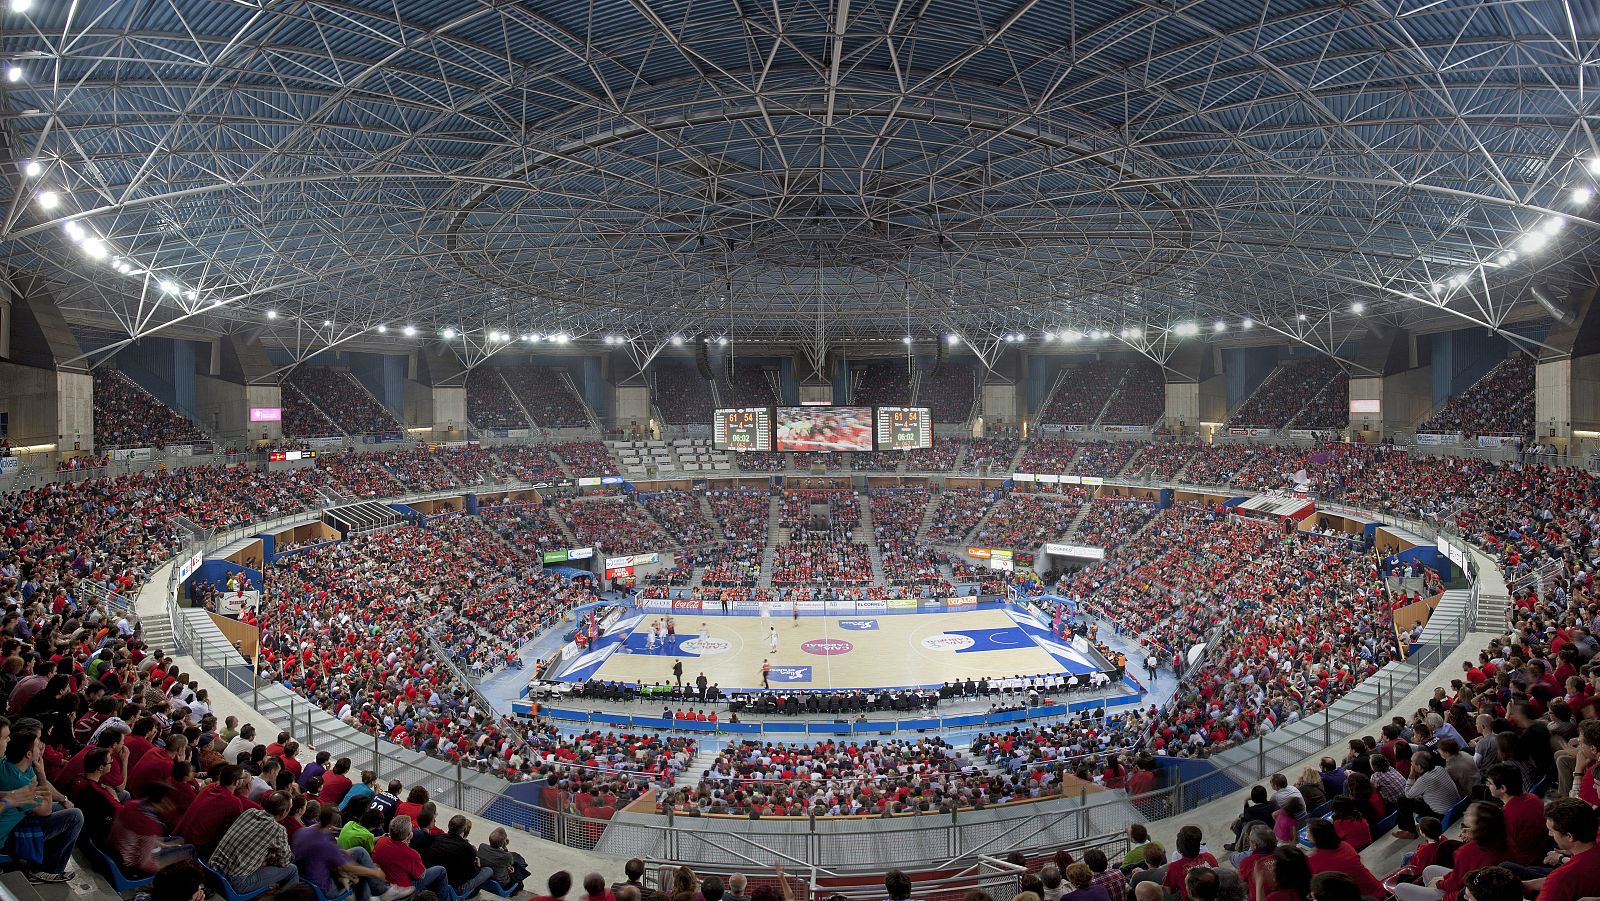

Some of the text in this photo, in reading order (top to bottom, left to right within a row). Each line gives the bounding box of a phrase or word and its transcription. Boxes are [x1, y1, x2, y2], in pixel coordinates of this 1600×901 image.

[729, 413, 737, 421] 61
[744, 413, 752, 421] 54
[895, 412, 903, 420] 61
[909, 412, 917, 420] 54
[732, 434, 750, 442] 06:02
[897, 433, 914, 441] 06:02
